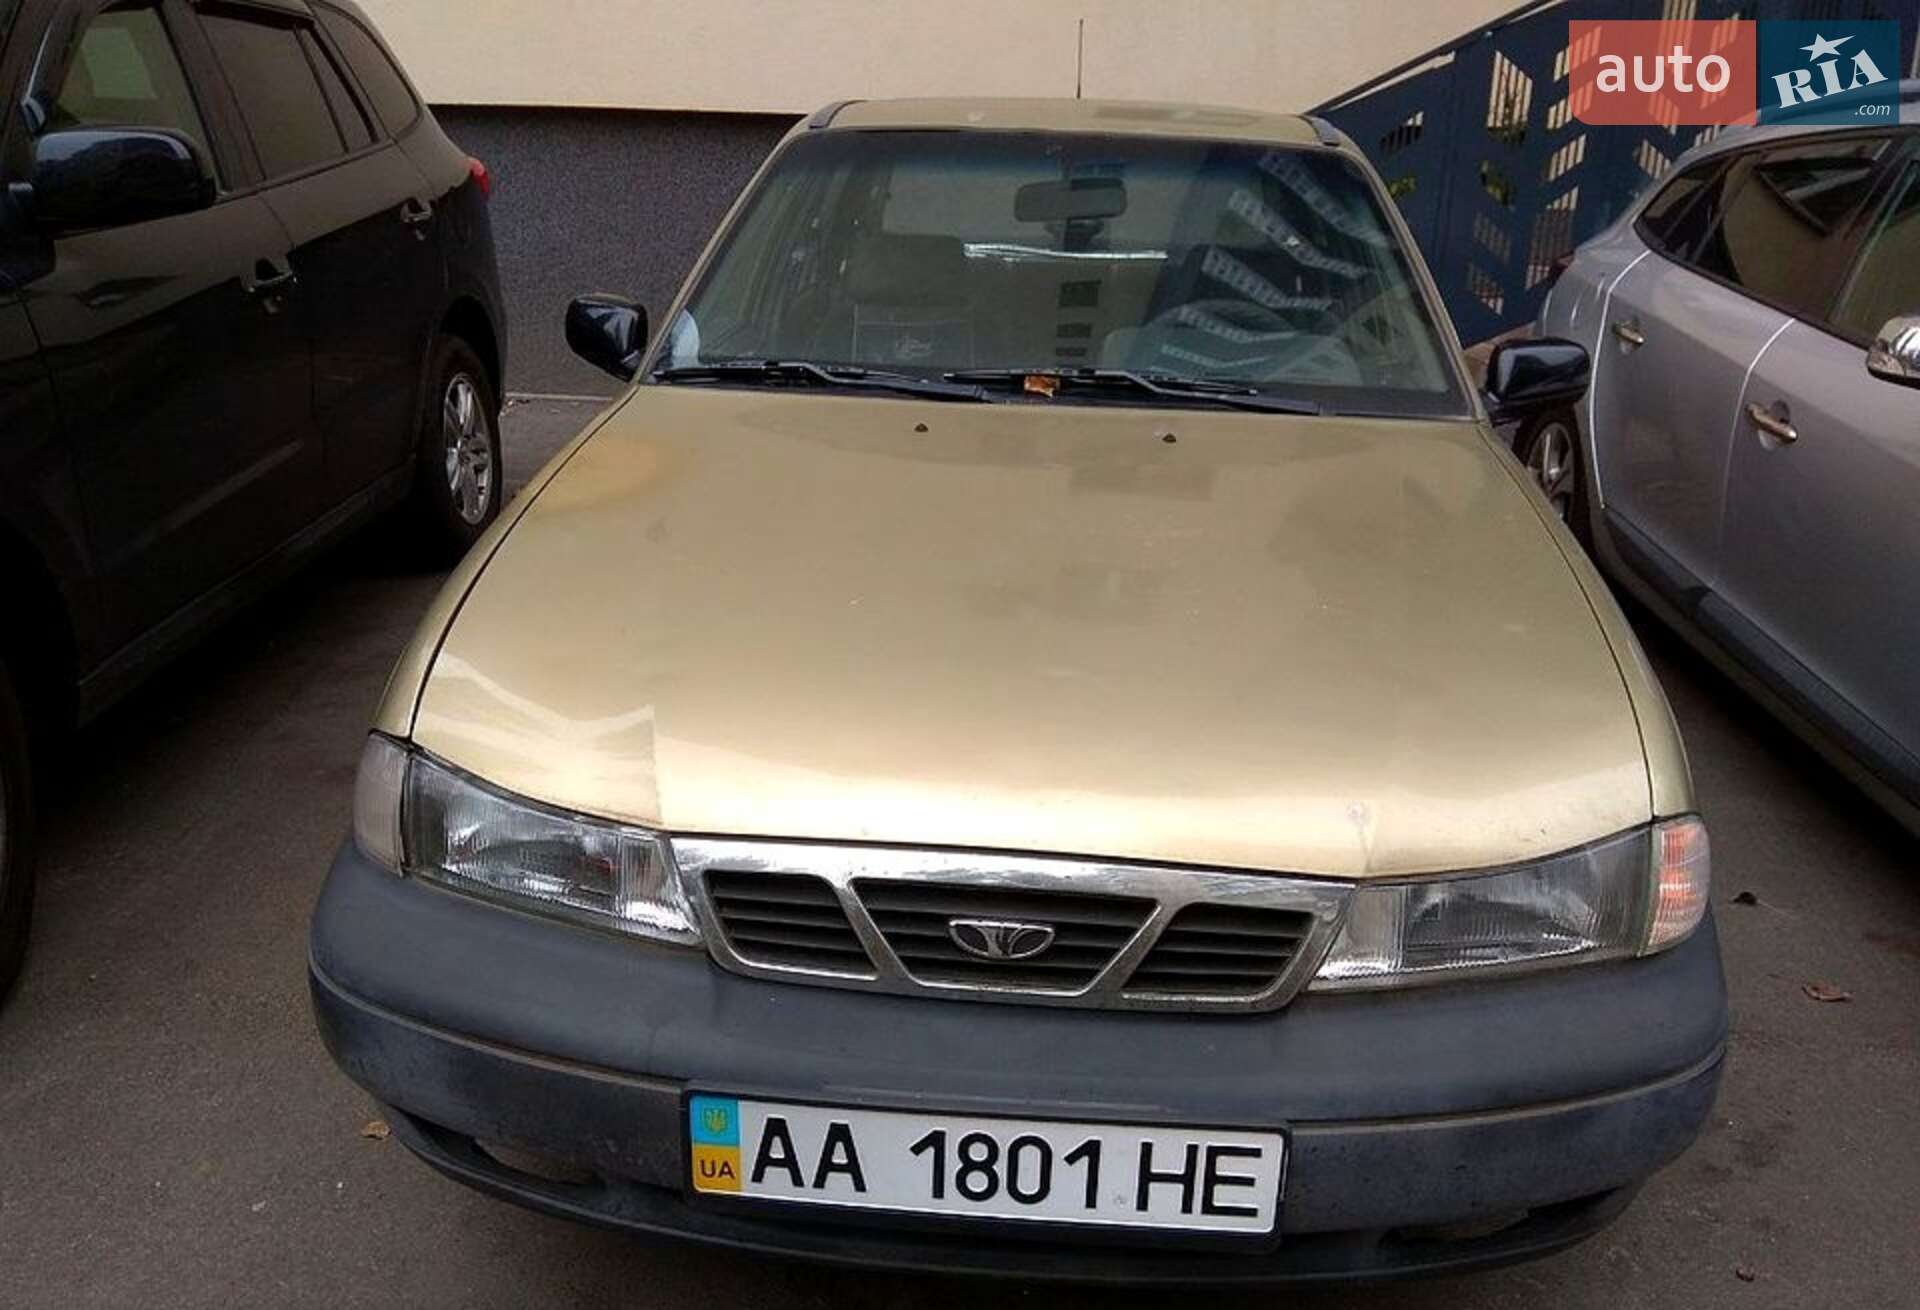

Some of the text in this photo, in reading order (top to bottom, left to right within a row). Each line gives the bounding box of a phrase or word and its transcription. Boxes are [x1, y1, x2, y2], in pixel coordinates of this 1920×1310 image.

[701, 1160, 735, 1181] UA
[750, 1117, 1264, 1217] AA 1801 HE
